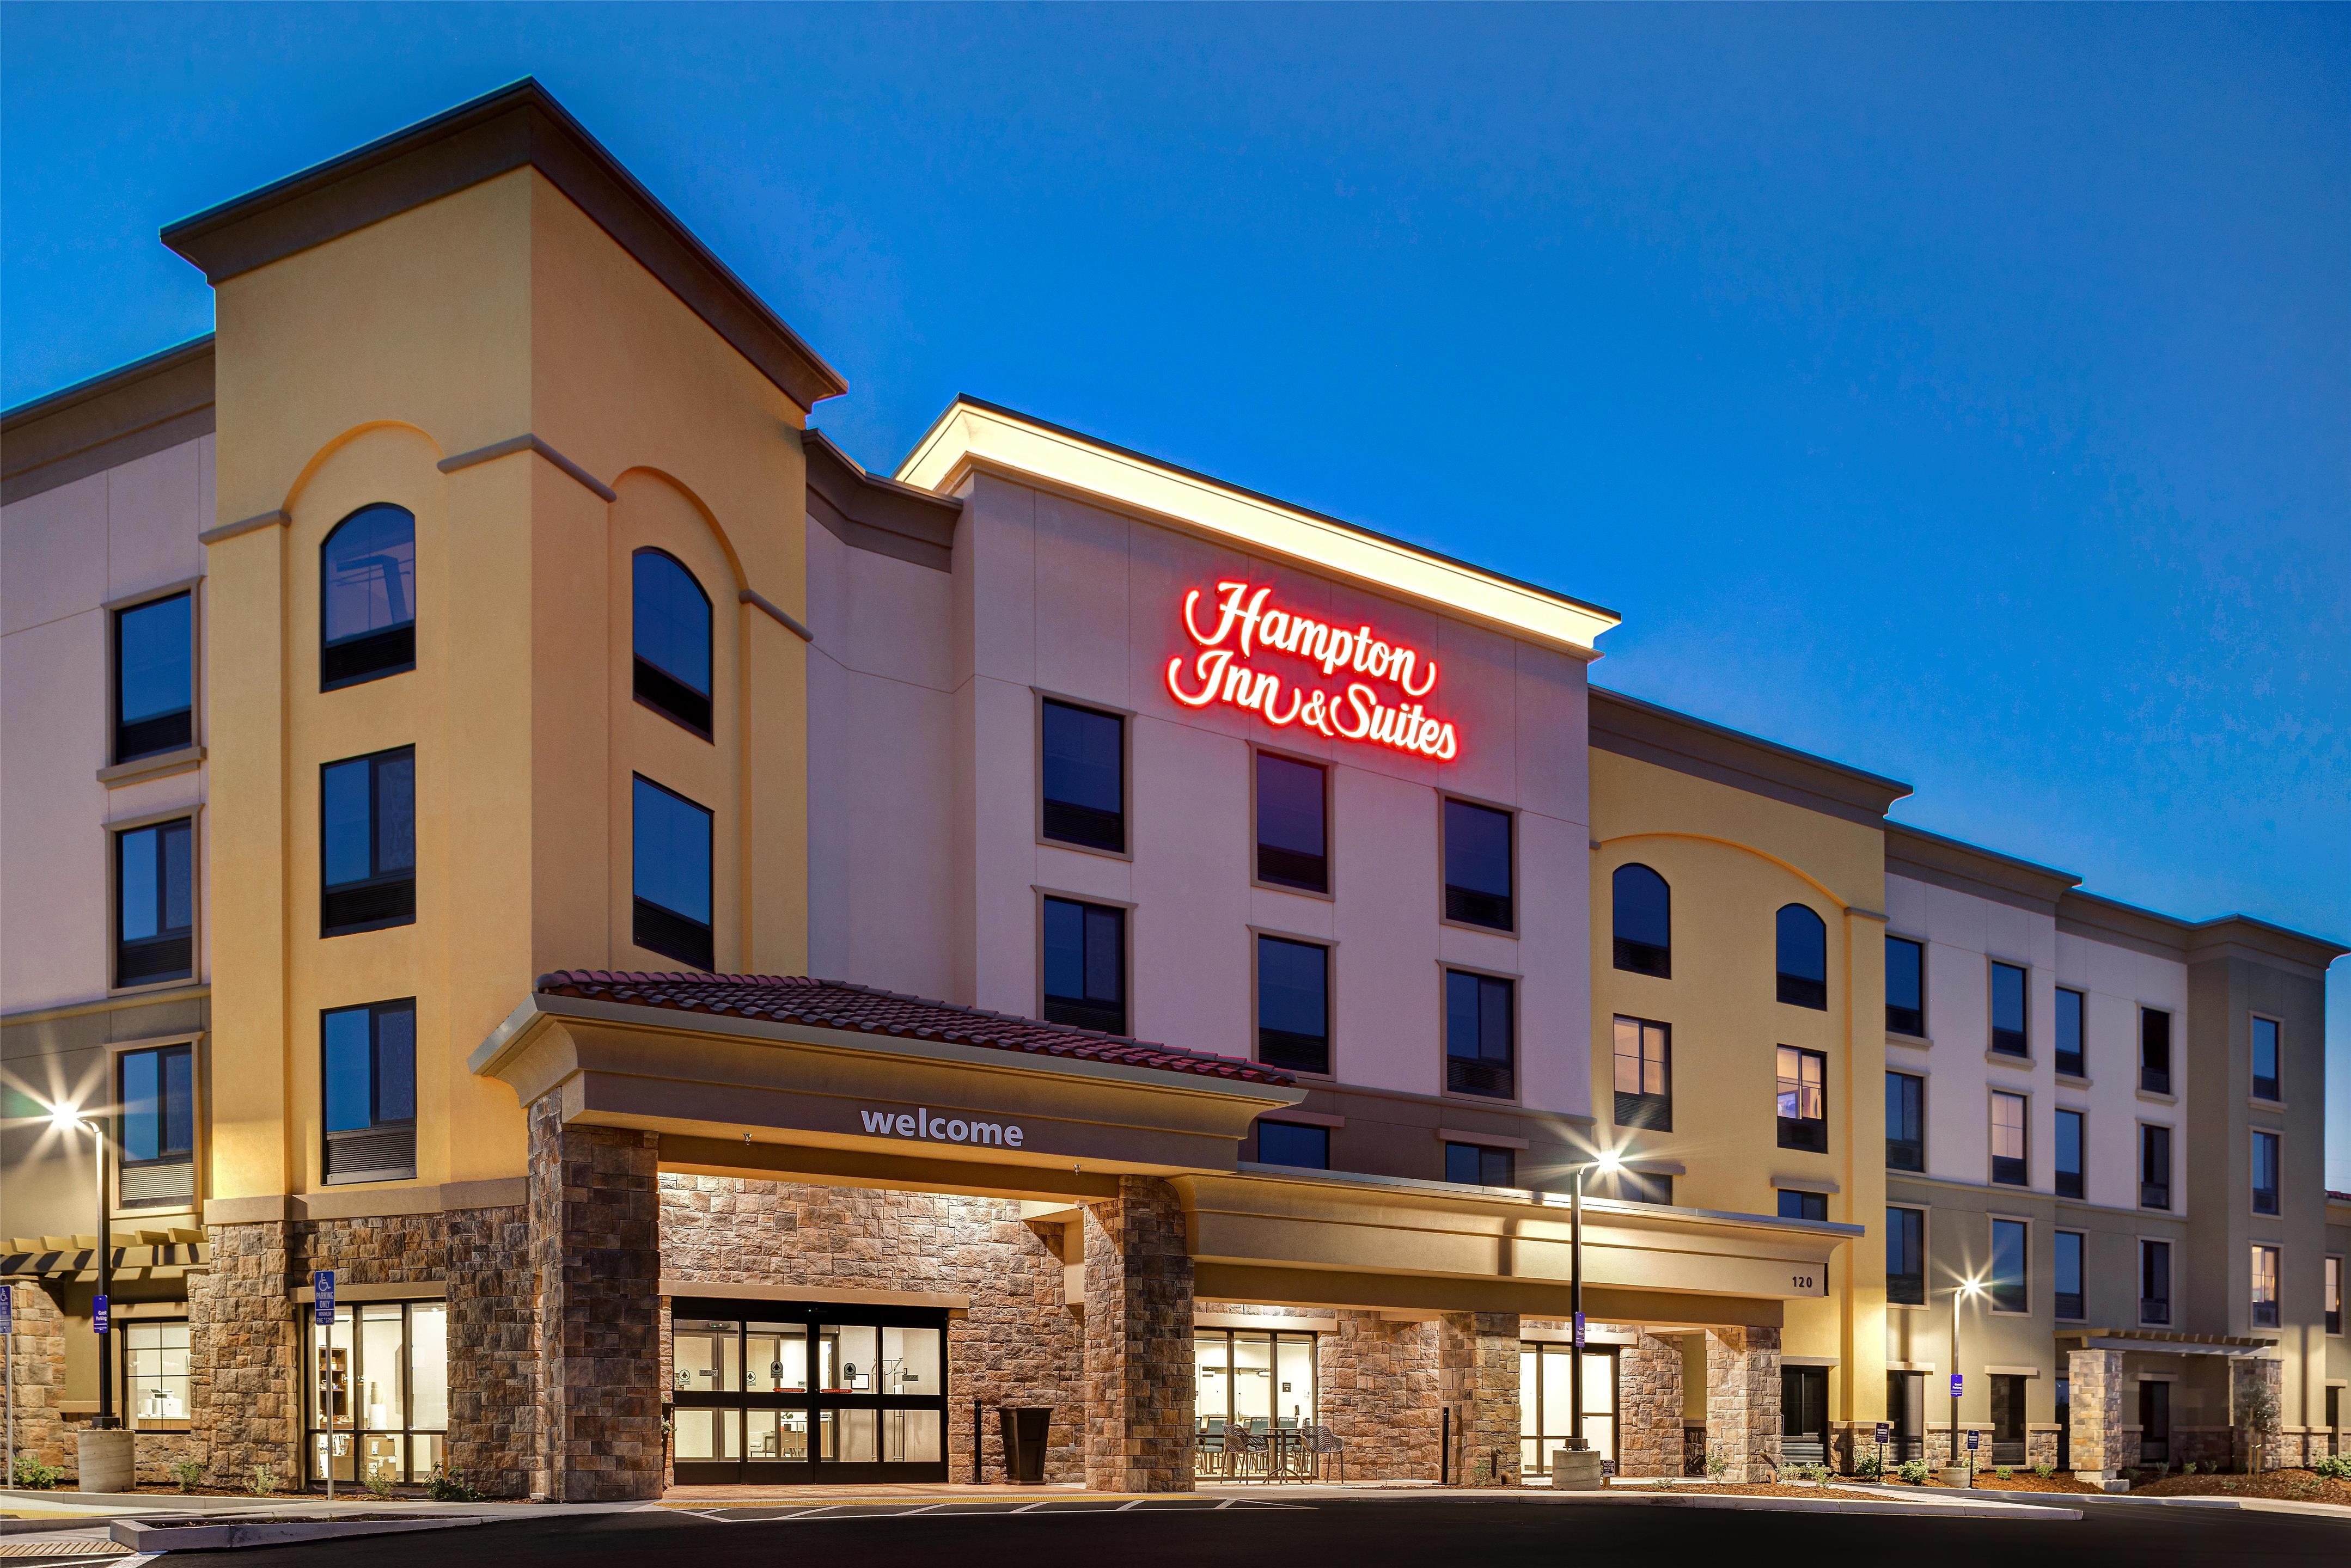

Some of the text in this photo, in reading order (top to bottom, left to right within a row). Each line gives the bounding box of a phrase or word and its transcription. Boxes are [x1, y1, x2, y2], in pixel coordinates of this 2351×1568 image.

[1185, 581, 1436, 696] Hampton
[1168, 650, 1457, 761] Inn & Suites
[860, 1107, 1024, 1147] welcome
[1792, 1276, 1813, 1288] 120
[320, 1300, 331, 1308] ONLY
